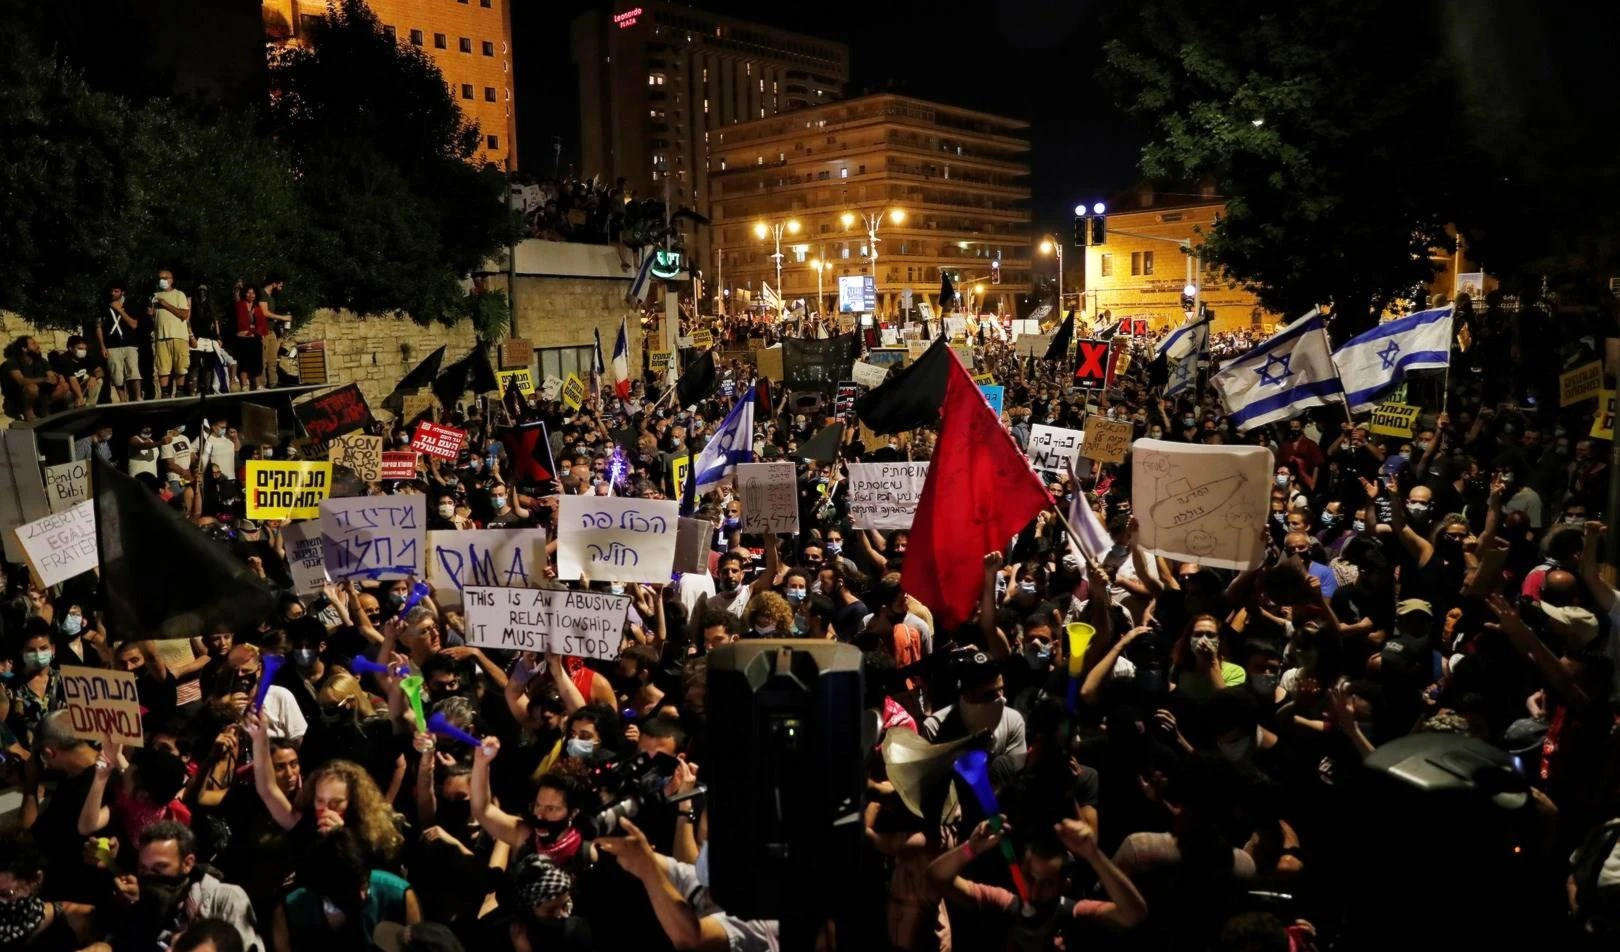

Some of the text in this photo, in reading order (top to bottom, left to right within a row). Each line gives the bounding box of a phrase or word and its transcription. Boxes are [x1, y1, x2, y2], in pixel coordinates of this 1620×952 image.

[614, 8, 642, 22] Leonardo
[620, 18, 636, 28] PLAZA
[1371, 414, 1409, 428] נמאסת
[413, 441, 456, 458] הממשלה
[421, 434, 459, 450] העם נגד
[46, 468, 71, 485] Bend
[257, 470, 325, 490] מנותקים
[56, 482, 84, 499] Bibi
[332, 505, 417, 533] מדינה
[582, 513, 613, 529] פה
[1173, 506, 1204, 524] צוללת
[331, 534, 417, 571] מחלה
[587, 541, 638, 566] חולה
[436, 543, 529, 589] PMA
[533, 591, 550, 607] AN
[502, 628, 547, 649] MUST
[64, 676, 136, 705] מנותקים
[69, 703, 141, 737] נמאסתם
